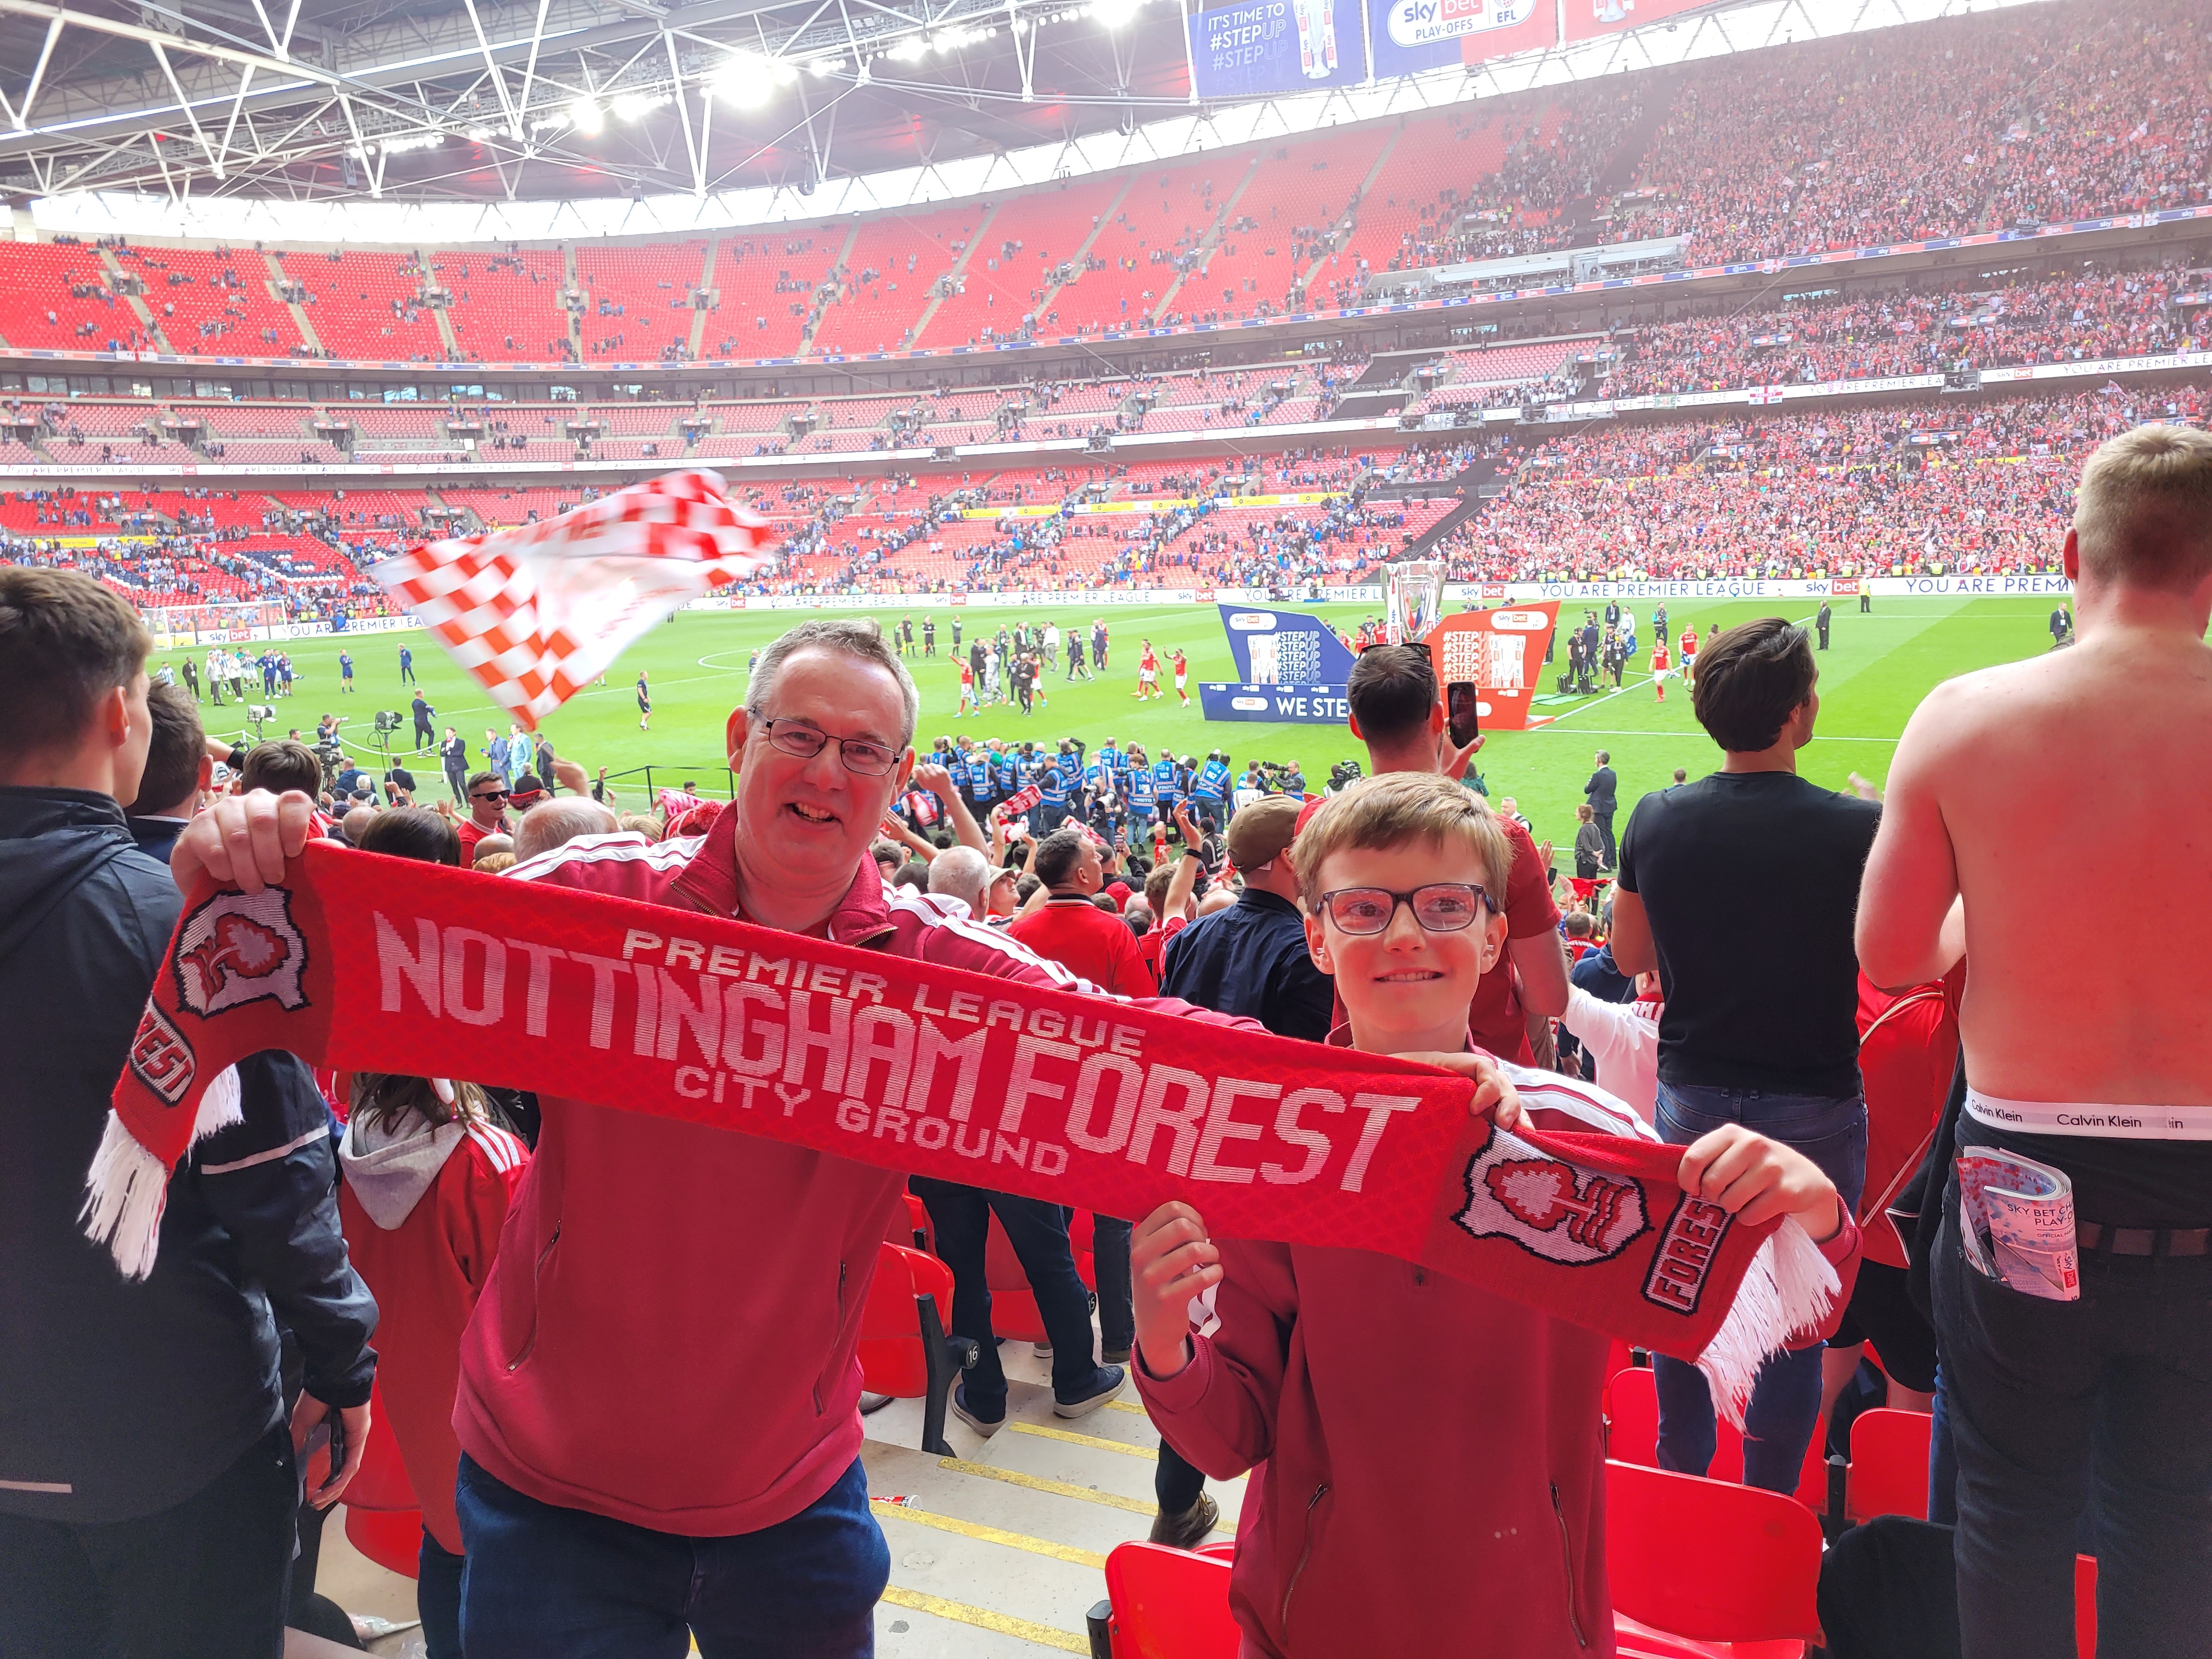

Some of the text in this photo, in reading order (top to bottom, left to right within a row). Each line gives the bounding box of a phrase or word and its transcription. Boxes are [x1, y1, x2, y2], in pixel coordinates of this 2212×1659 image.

[1208, 2, 1285, 32] IT'S TIME TO
[1404, 2, 1437, 23] sky
[1497, 10, 1516, 23] EFL
[1210, 19, 1286, 51] #STEPUP
[1416, 19, 1473, 40] PLAY-OFFS
[1212, 40, 1288, 71] #STEPUP
[2182, 210, 2194, 219] sky
[2064, 365, 2091, 374] YOU
[2098, 364, 2122, 373] ARE
[2129, 356, 2188, 369] PREMIER
[1865, 379, 1915, 390] PREMIER
[1616, 400, 1634, 409] ARE
[1687, 393, 1728, 404] LEAGUE
[1462, 586, 1503, 599] sky bet
[1540, 582, 1765, 596] YOU ARE PREMIER LEAGUE
[1806, 580, 1858, 594] sky bet
[1906, 578, 2069, 593] YOU ARE PREMI
[869, 595, 910, 606] LEAGUE
[950, 595, 966, 604] bet
[1022, 594, 1043, 604] ARE
[1048, 592, 1098, 603] PREMIER
[1104, 592, 1150, 603] LEAGUE
[1178, 590, 1213, 602] sky bet
[1319, 588, 1367, 600] REMIER
[732, 599, 745, 607] bet
[209, 630, 250, 644] sky bet
[1274, 631, 1320, 642] #STEPUP
[1276, 641, 1321, 652] #STEPUP
[1277, 651, 1321, 662] #STEPUP
[1277, 661, 1321, 672] #STEPUP
[1277, 670, 1321, 681] #STEPUP
[1276, 697, 1348, 718] WE STE
[622, 928, 1147, 1058] PREMIER LEAGUE
[371, 910, 1423, 1193] NOTTINGHAM FOREST
[1972, 1099, 2023, 1123] Calvin Klein
[674, 1065, 1069, 1177] CITY GROUND
[2057, 1114, 2142, 1128] Calvin Klein
[2169, 1117, 2183, 1129] in
[2007, 1204, 2030, 1215] SKY
[2035, 1211, 2073, 1226] PLAY-O
[1651, 1196, 1727, 1307] FORES
[2064, 1256, 2073, 1269] sky
[2067, 1270, 2075, 1286] bet
[1088, 1297, 1096, 1311] 15
[969, 1346, 978, 1363] 16
